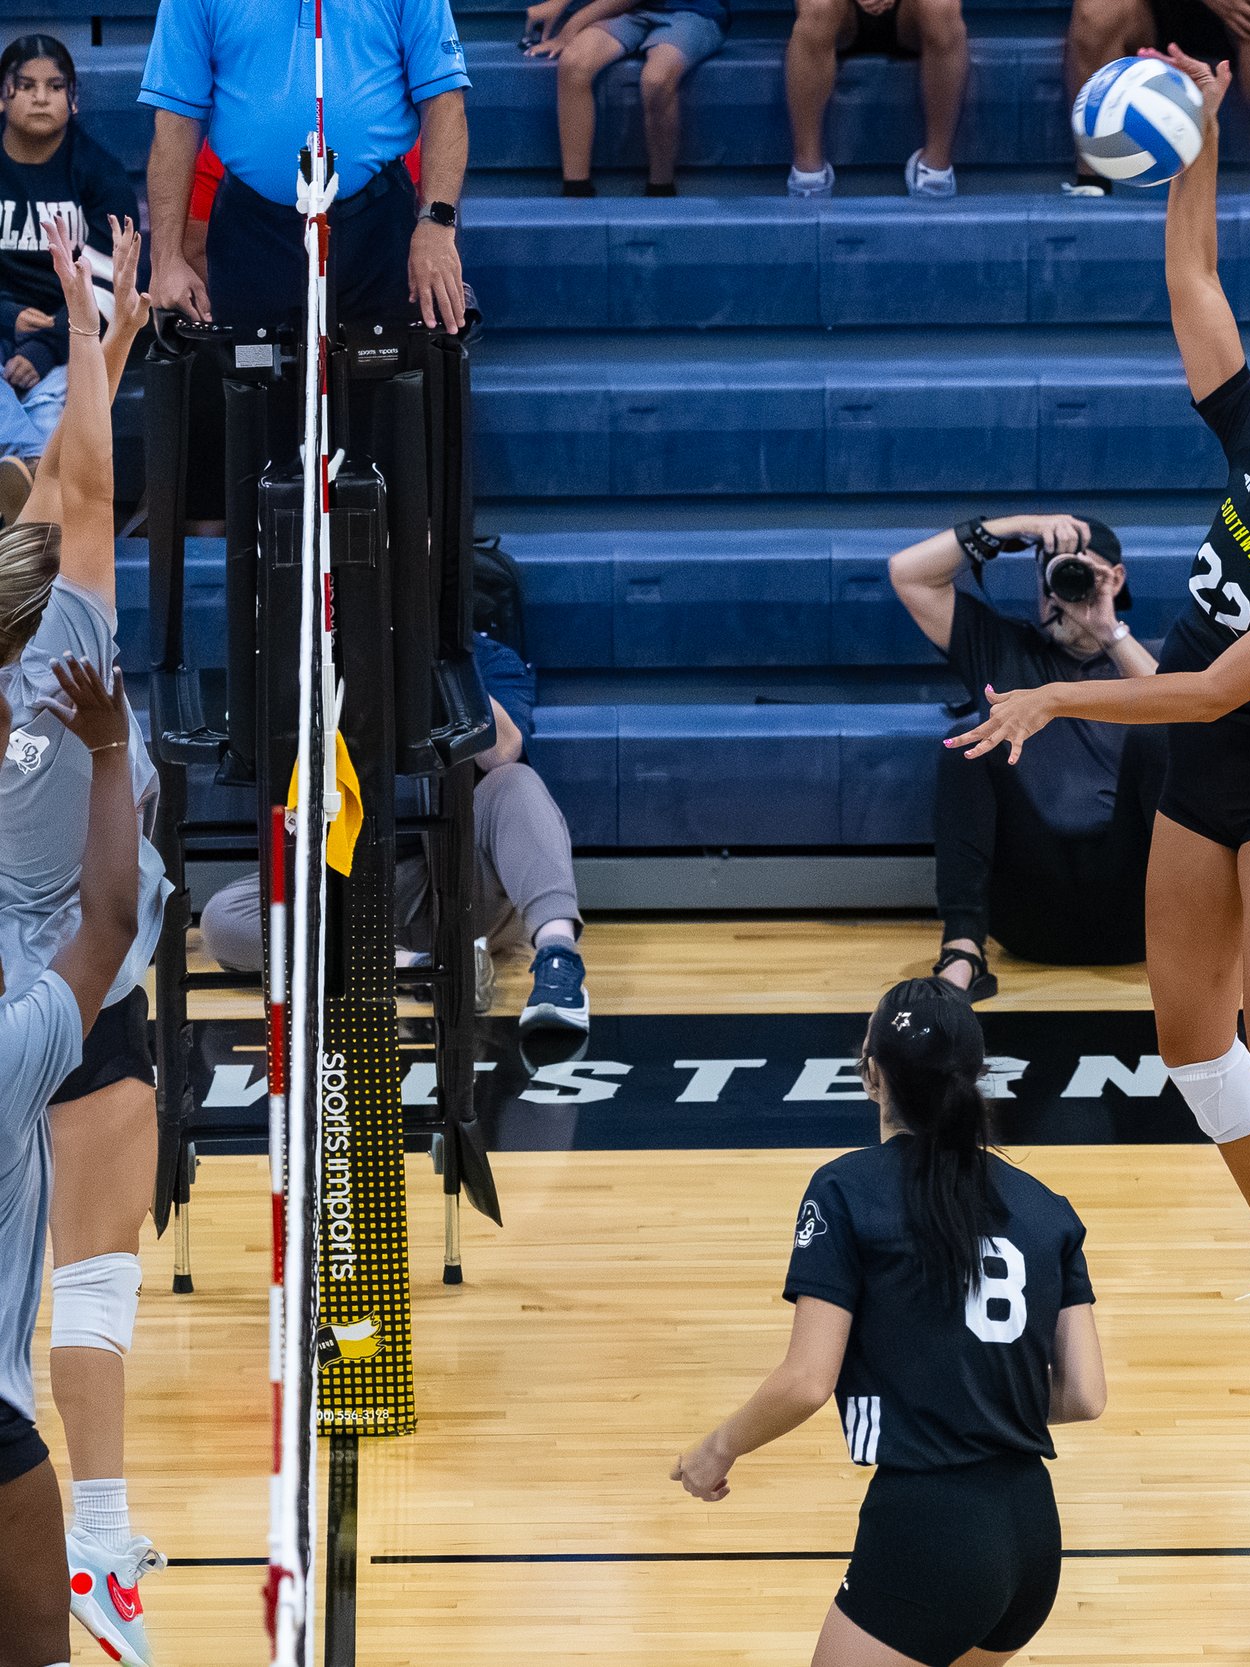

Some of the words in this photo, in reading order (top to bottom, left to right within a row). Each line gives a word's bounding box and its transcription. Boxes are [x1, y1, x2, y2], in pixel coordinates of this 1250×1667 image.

[322, 1052, 352, 1152] sports
[322, 1158, 358, 1280] imports
[964, 1236, 1028, 1344] 8
[338, 1409, 389, 1420] 556-3198
